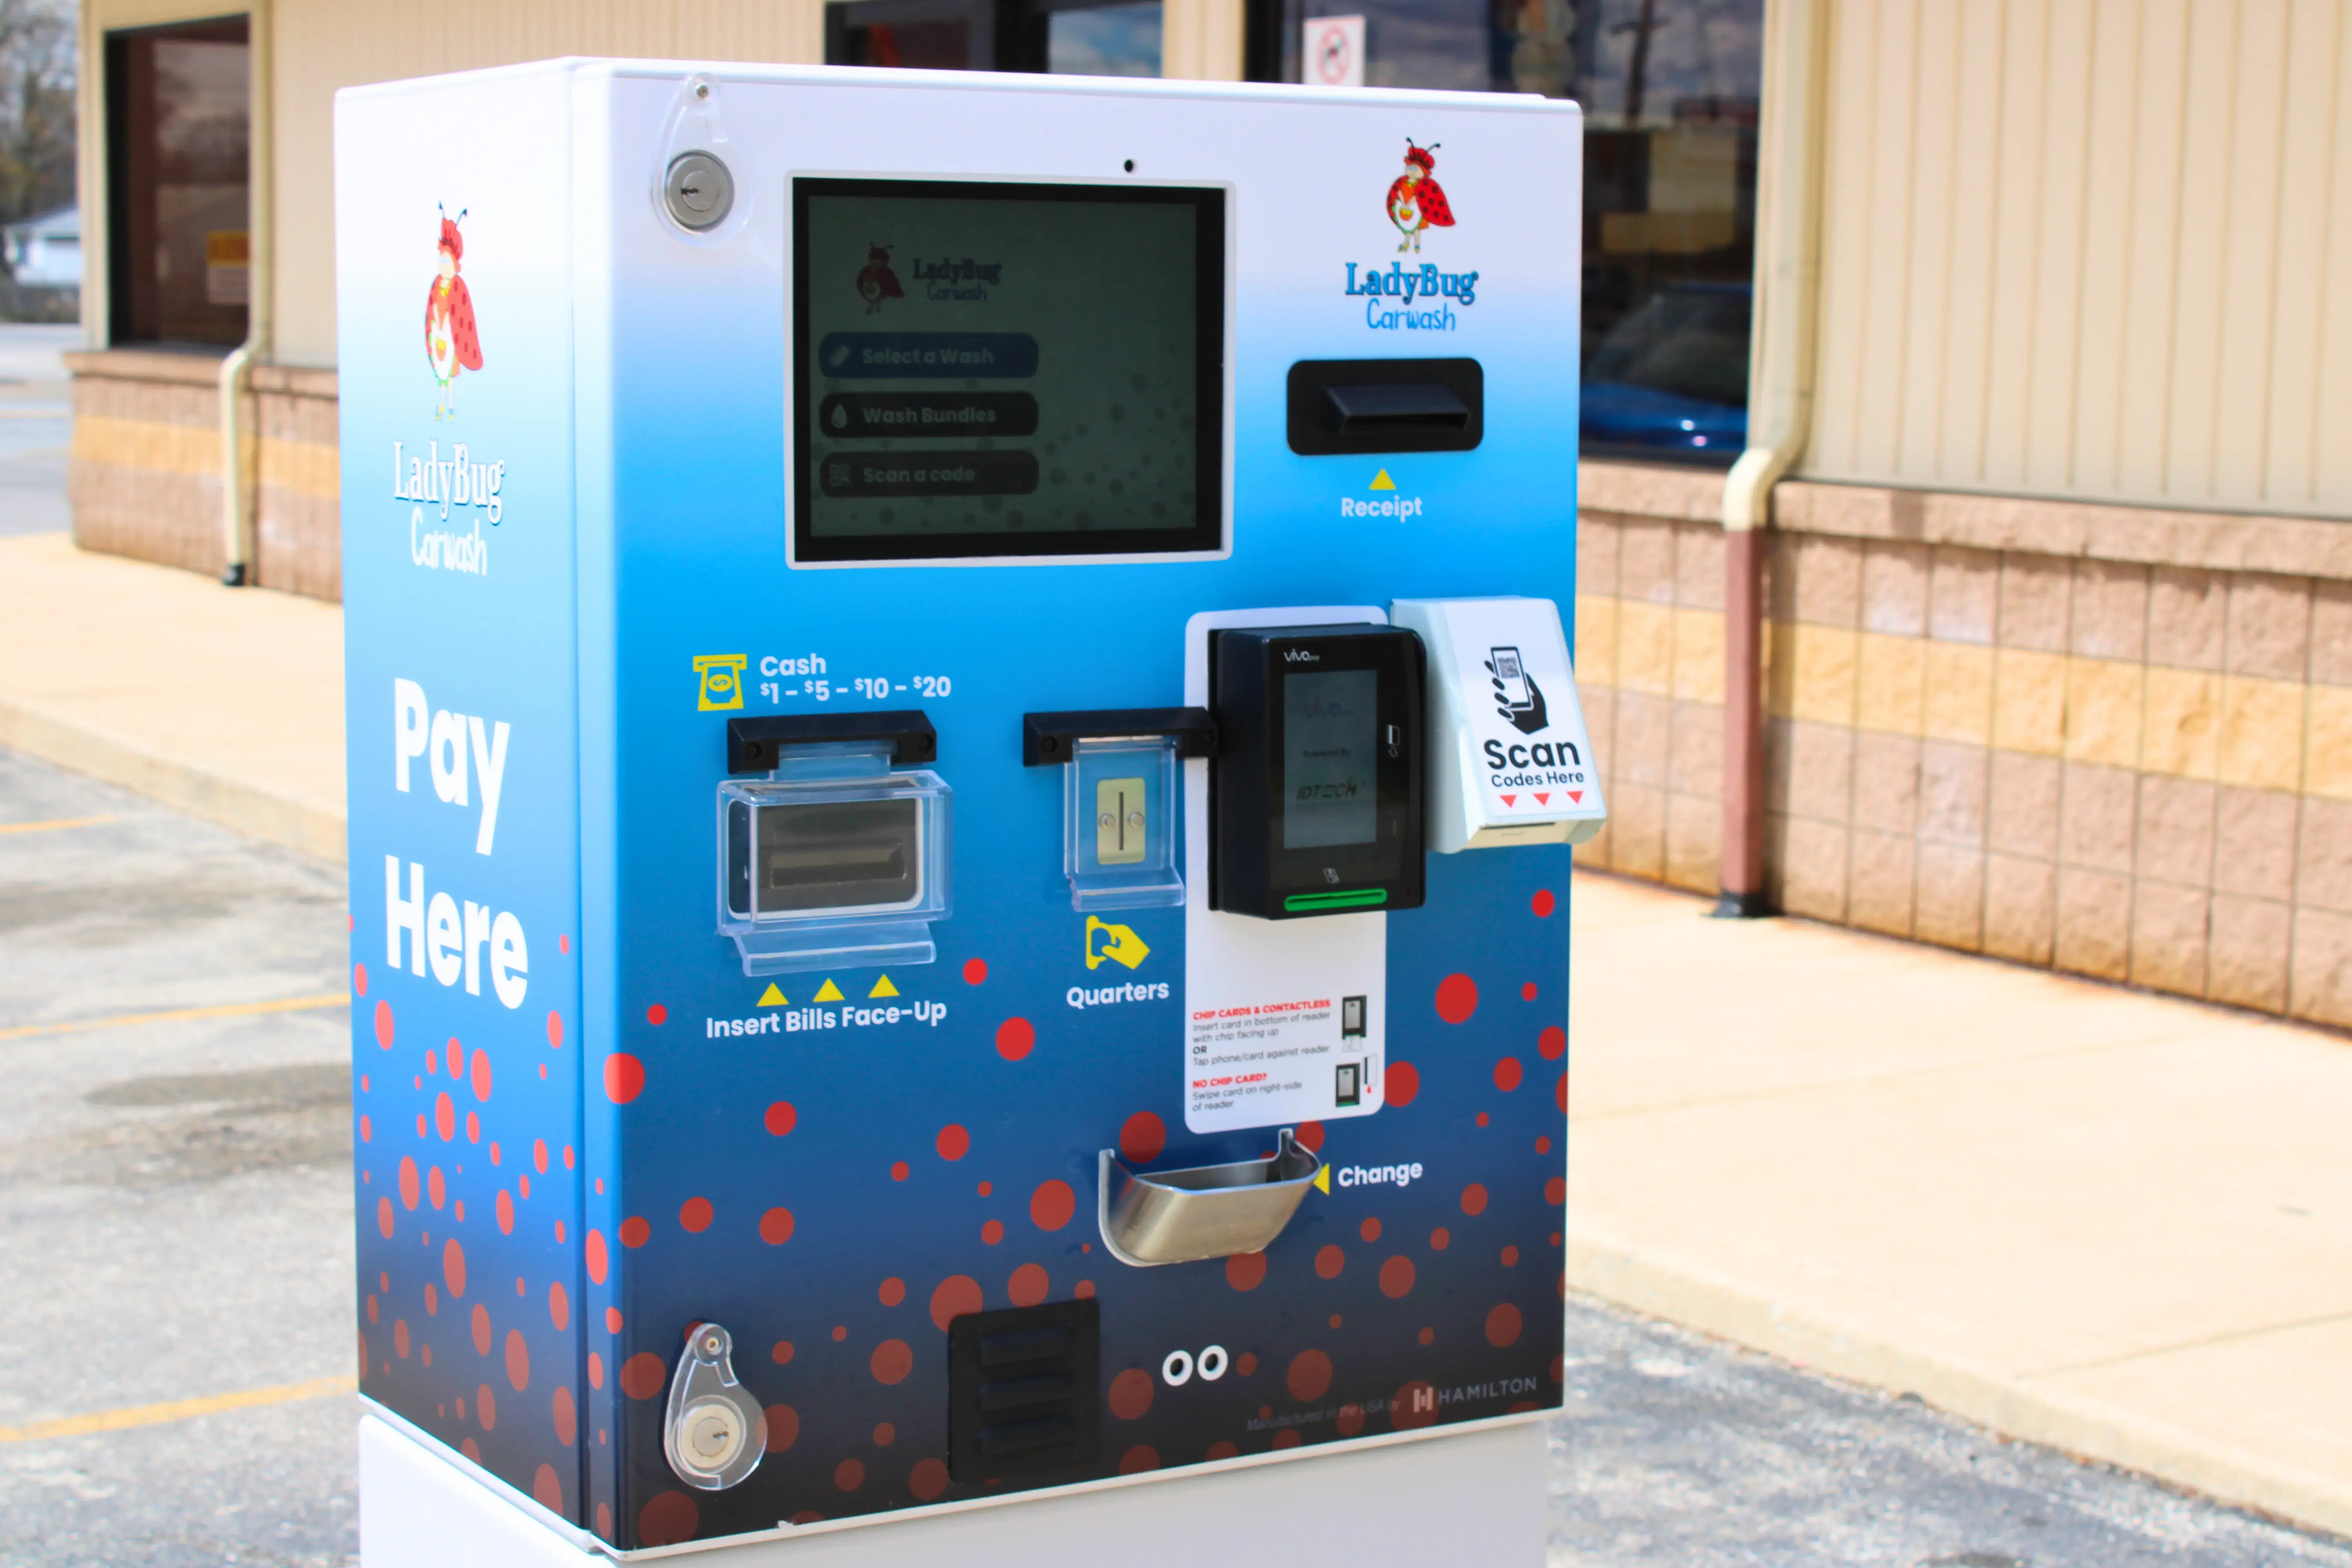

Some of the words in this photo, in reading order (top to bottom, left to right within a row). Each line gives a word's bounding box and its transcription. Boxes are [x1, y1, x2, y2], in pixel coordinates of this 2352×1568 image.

[913, 257, 1002, 285] LadyBug
[927, 280, 988, 301] Carwash
[1345, 261, 1479, 306] LadyBug
[1367, 297, 1456, 331] Carwash
[862, 347, 920, 364] Select
[924, 350, 935, 364] a
[940, 347, 994, 364] Wash
[862, 407, 917, 423] Wash
[921, 406, 997, 423] Bundles
[394, 440, 506, 526] LadyBug
[863, 466, 910, 483] Scan
[914, 469, 925, 483] a
[929, 465, 976, 483] code
[1341, 494, 1423, 523] Receipt
[411, 506, 487, 576] Carwash
[760, 653, 826, 677] Cash
[760, 682, 779, 704] $1
[804, 680, 830, 702] $5
[854, 677, 889, 700] $10
[913, 675, 951, 697] $20
[394, 677, 511, 856] Pay
[1484, 739, 1581, 770] Scan
[1491, 772, 1543, 788] Codes
[1546, 771, 1584, 784] Here
[385, 855, 528, 1009] Here
[1066, 982, 1170, 1010] Quarters
[706, 1012, 780, 1038] Insert
[786, 1007, 836, 1032] Bills
[842, 1000, 947, 1027] Face-Up
[1193, 1011, 1216, 1020] CHIP
[1219, 1007, 1251, 1018] CARDS
[1263, 999, 1331, 1013] CONTACTLESS
[1193, 1022, 1218, 1032] Insert
[1221, 1019, 1241, 1029] card
[1244, 1018, 1252, 1027] in
[1255, 1015, 1288, 1026] bottom
[1290, 1013, 1300, 1022] of
[1302, 1011, 1331, 1021] reader
[1193, 1033, 1213, 1044] with
[1215, 1031, 1235, 1042] chip
[1236, 1029, 1265, 1040] facing
[1267, 1028, 1279, 1037] up
[1193, 1045, 1207, 1055] OR
[1194, 1057, 1209, 1067] Tap
[1212, 1051, 1264, 1065] phone/card
[1267, 1047, 1298, 1060] against
[1301, 1044, 1330, 1054] reader
[1193, 1079, 1207, 1089] NO
[1210, 1076, 1233, 1087] CHIP
[1235, 1073, 1268, 1084] CARD?
[1193, 1091, 1220, 1100] Swipe
[1223, 1087, 1243, 1097] card
[1245, 1086, 1257, 1095] on
[1259, 1081, 1303, 1094] right-side
[1192, 1103, 1202, 1112] of
[1205, 1100, 1234, 1110] reader
[1338, 1162, 1423, 1187] Change
[1438, 1376, 1537, 1405] HAMILTON
